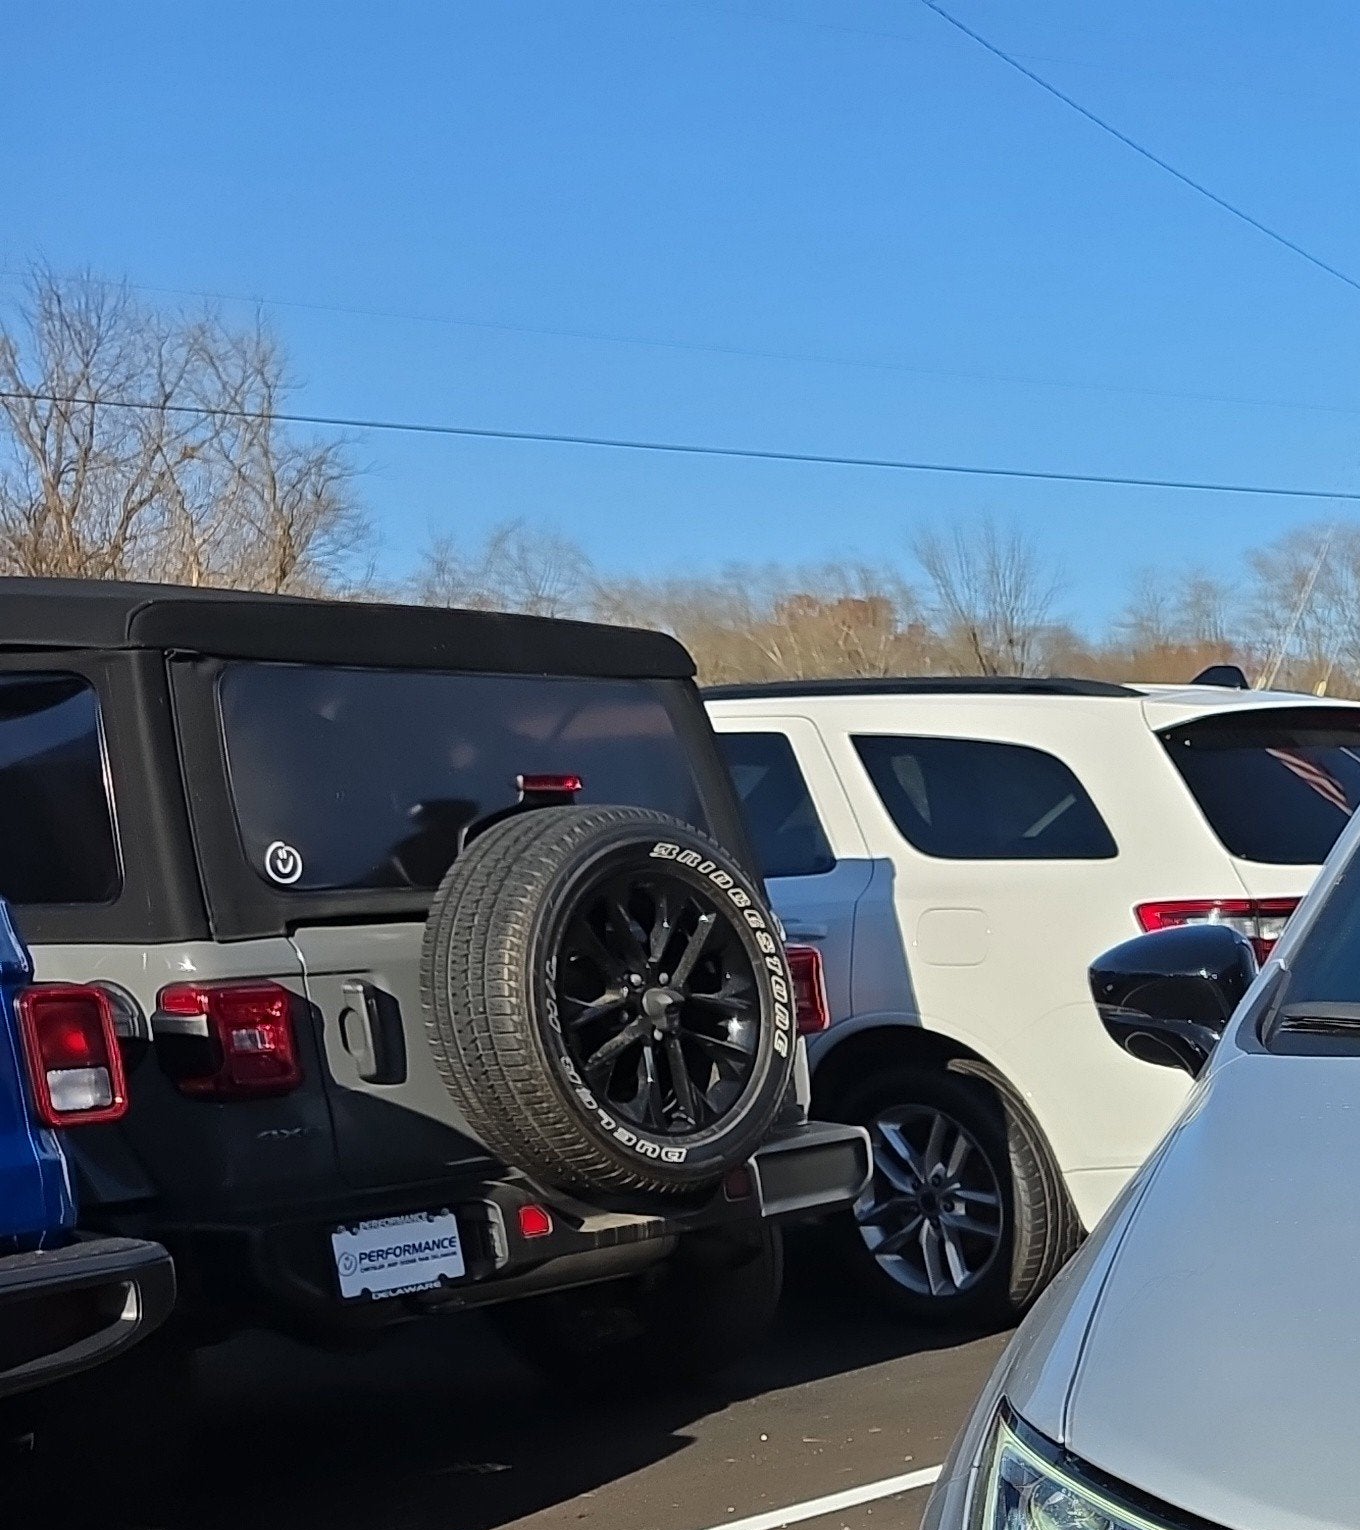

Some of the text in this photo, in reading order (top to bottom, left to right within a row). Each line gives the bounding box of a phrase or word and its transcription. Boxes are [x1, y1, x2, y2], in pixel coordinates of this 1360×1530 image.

[650, 842, 788, 1058] BRIDGESTONE
[358, 1236, 458, 1264] PERFORMANCE
[371, 1280, 442, 1300] DELAWARE
